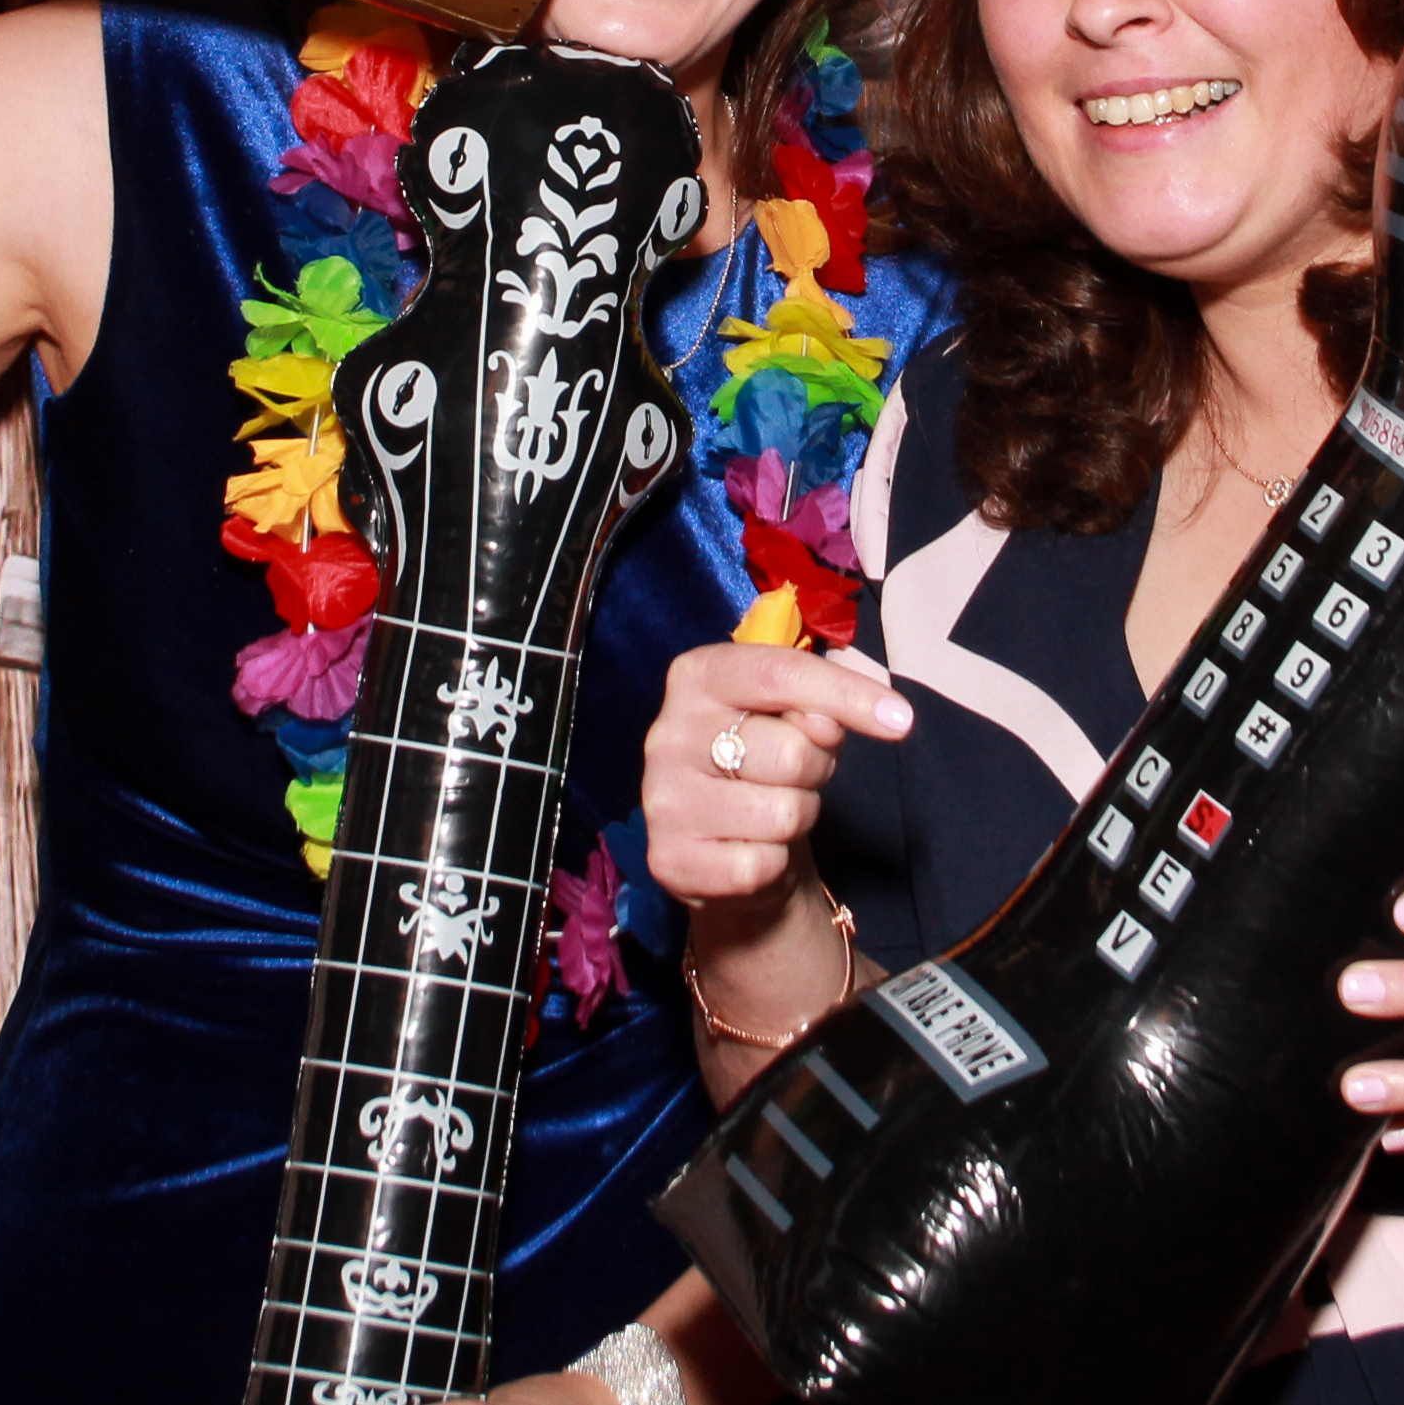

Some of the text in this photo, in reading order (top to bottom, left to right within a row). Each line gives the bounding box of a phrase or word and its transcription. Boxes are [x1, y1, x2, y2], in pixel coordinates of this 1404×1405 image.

[1309, 494, 1332, 524] 2
[1366, 536, 1391, 567] 3
[1270, 553, 1293, 582] 5
[1232, 612, 1254, 641] 8
[1328, 597, 1353, 627] 6
[1290, 658, 1314, 688] 9
[1136, 756, 1159, 787] C
[1097, 813, 1116, 848] L
[1149, 857, 1180, 897] E
[1111, 916, 1140, 951] V
[935, 1013, 1014, 1077] PHONE
